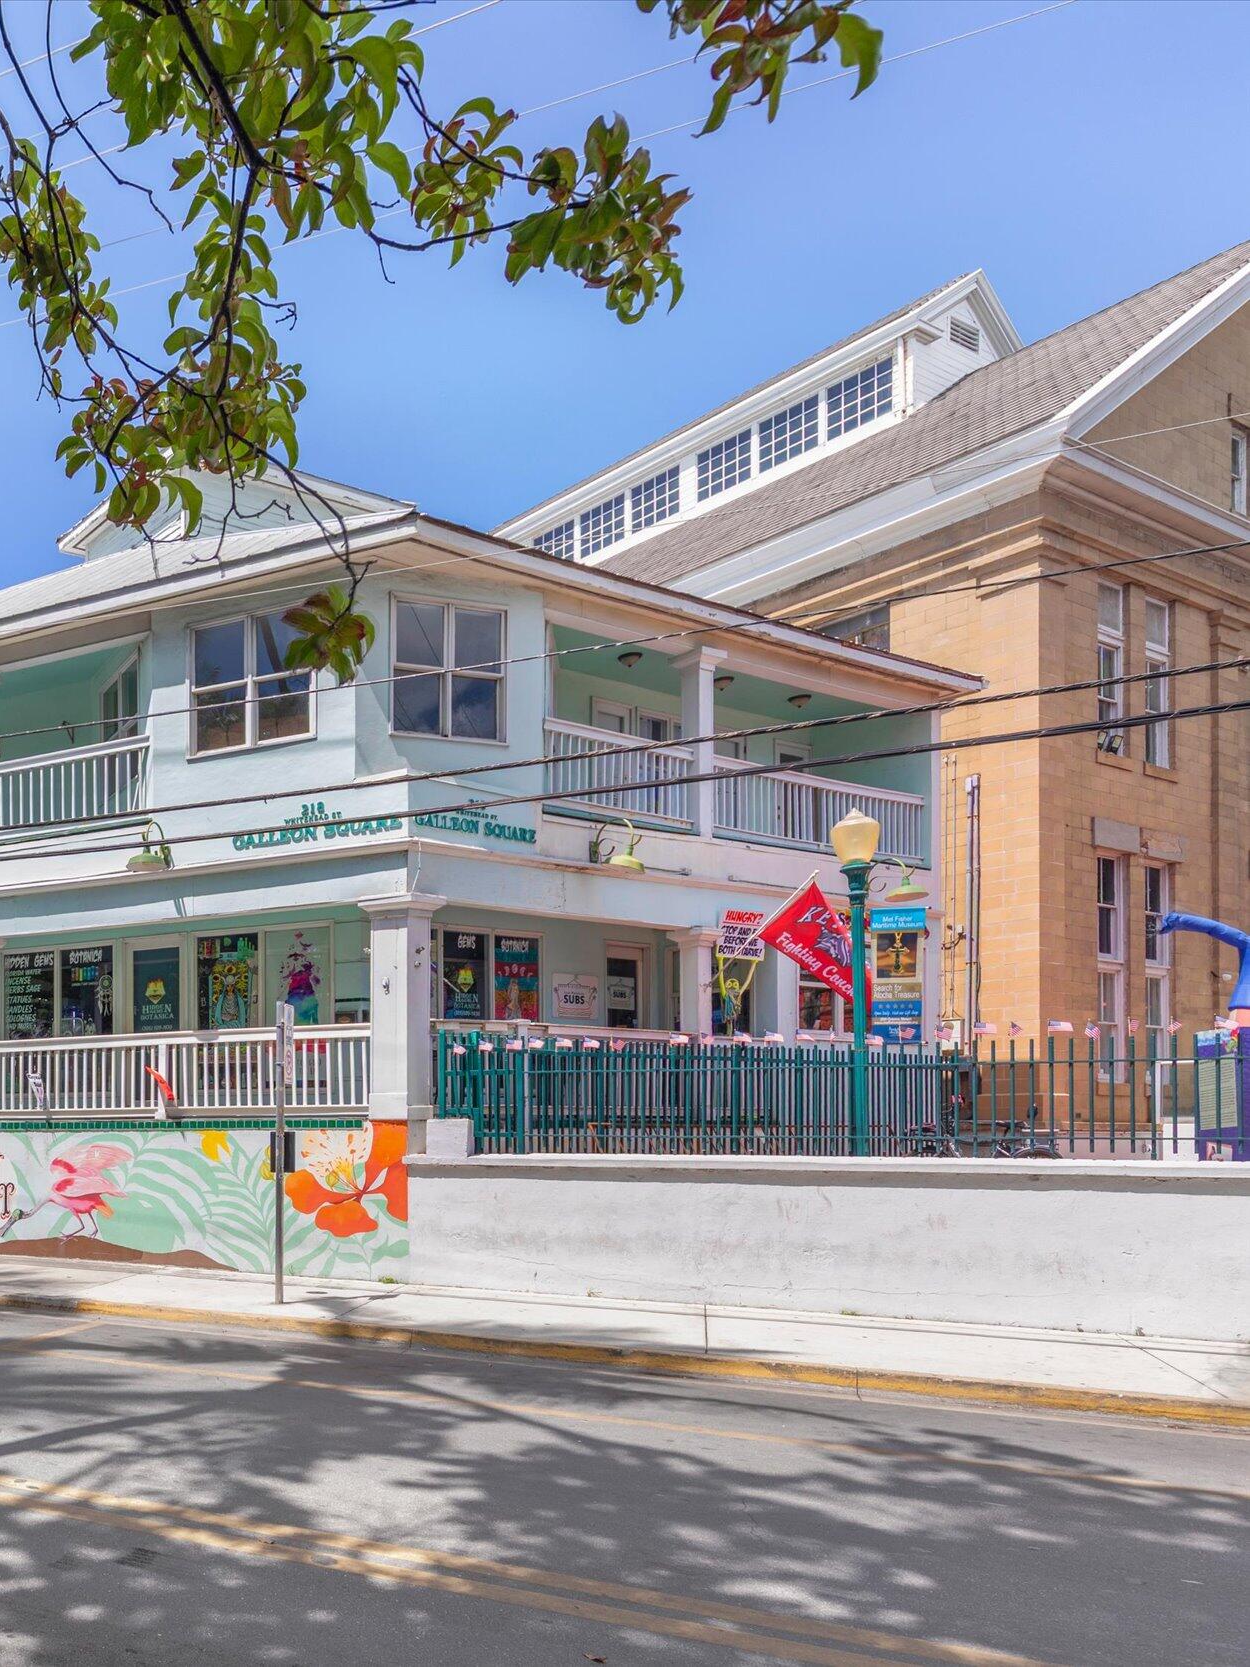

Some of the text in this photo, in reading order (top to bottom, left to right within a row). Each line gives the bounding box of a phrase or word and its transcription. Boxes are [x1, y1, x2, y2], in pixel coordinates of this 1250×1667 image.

[232, 816, 403, 851] GALLEON SQUARE
[414, 812, 537, 844] GALLEON SQUARE
[725, 910, 764, 925] HUNGRY?
[737, 927, 752, 937] AND
[458, 934, 476, 949] GEMS
[718, 944, 736, 955] BOTH
[776, 931, 823, 972] Fighting
[34, 952, 54, 968] GEMS
[69, 949, 103, 964] BOTANICA
[26, 984, 42, 993] SAGE
[873, 983, 902, 992] Search for
[563, 994, 585, 1005] SUBS
[613, 991, 627, 999] SUBS
[894, 991, 920, 999] Treasure
[140, 1012, 175, 1021] BOTANICA
